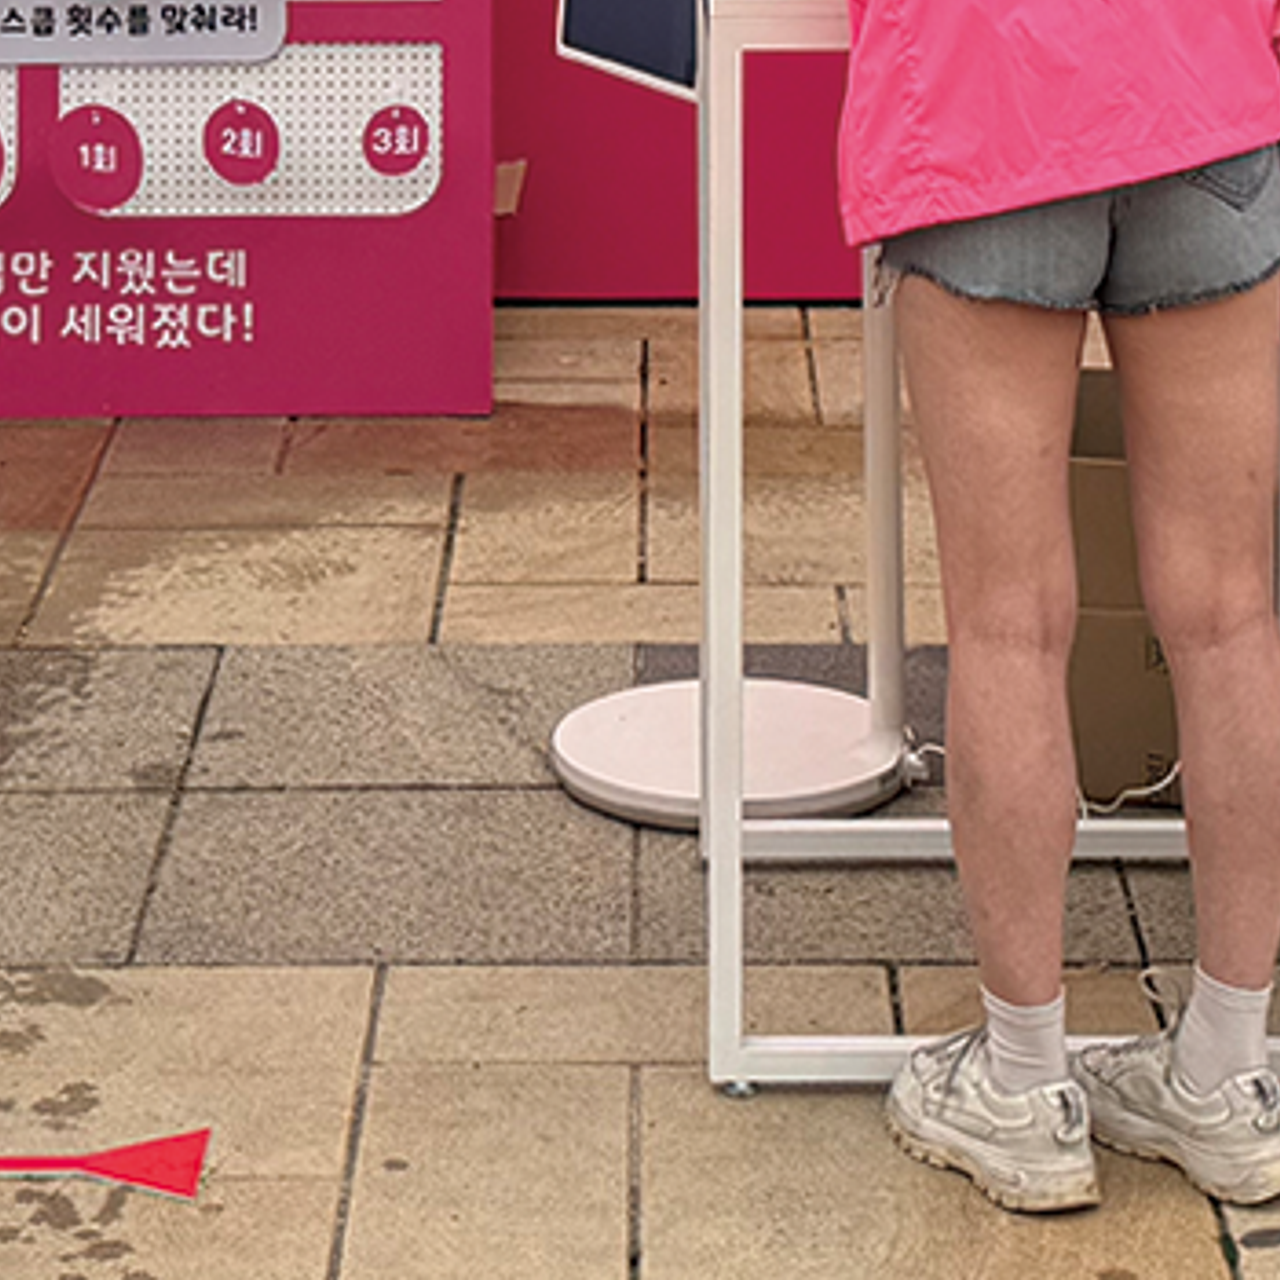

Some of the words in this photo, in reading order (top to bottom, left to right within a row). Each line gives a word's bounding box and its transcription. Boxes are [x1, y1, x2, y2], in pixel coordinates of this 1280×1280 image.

[160, 4, 258, 35] 맞춰라!
[220, 127, 263, 159] 2회
[371, 124, 420, 156] 3회
[77, 142, 117, 173] 1회
[70, 247, 249, 296] 지웠는데
[58, 300, 256, 350] 세워졌다!
